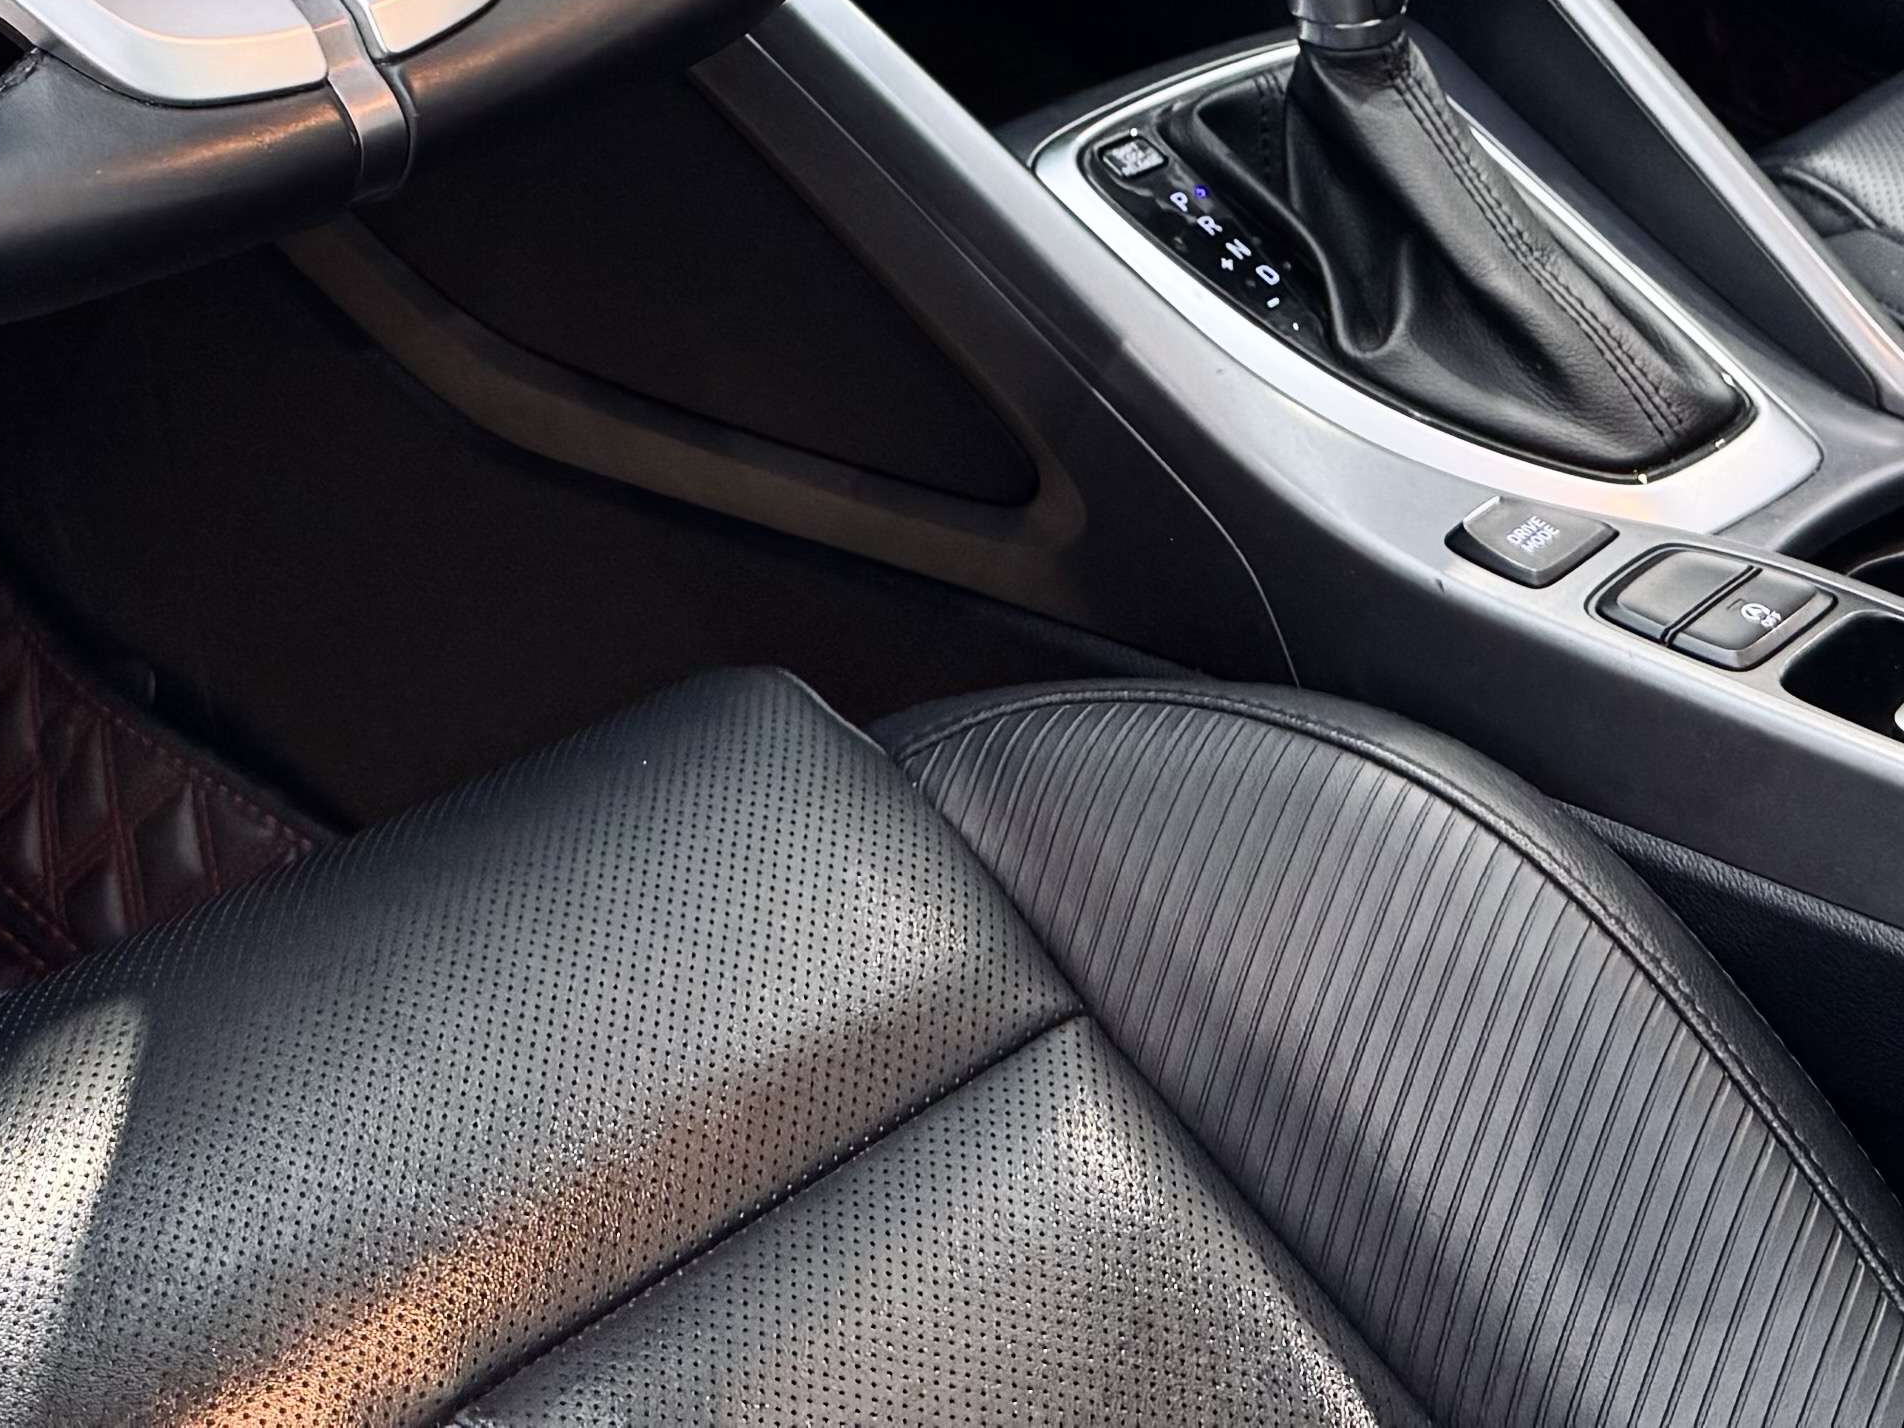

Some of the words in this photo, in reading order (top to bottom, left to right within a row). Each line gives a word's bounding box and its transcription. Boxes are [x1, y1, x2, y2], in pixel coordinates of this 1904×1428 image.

[1169, 191, 1188, 212] P
[1196, 215, 1223, 236] R
[1225, 238, 1252, 260] N
[1255, 264, 1280, 286] D
[1506, 515, 1547, 545] DRIVE
[1521, 521, 1561, 554] MODE
